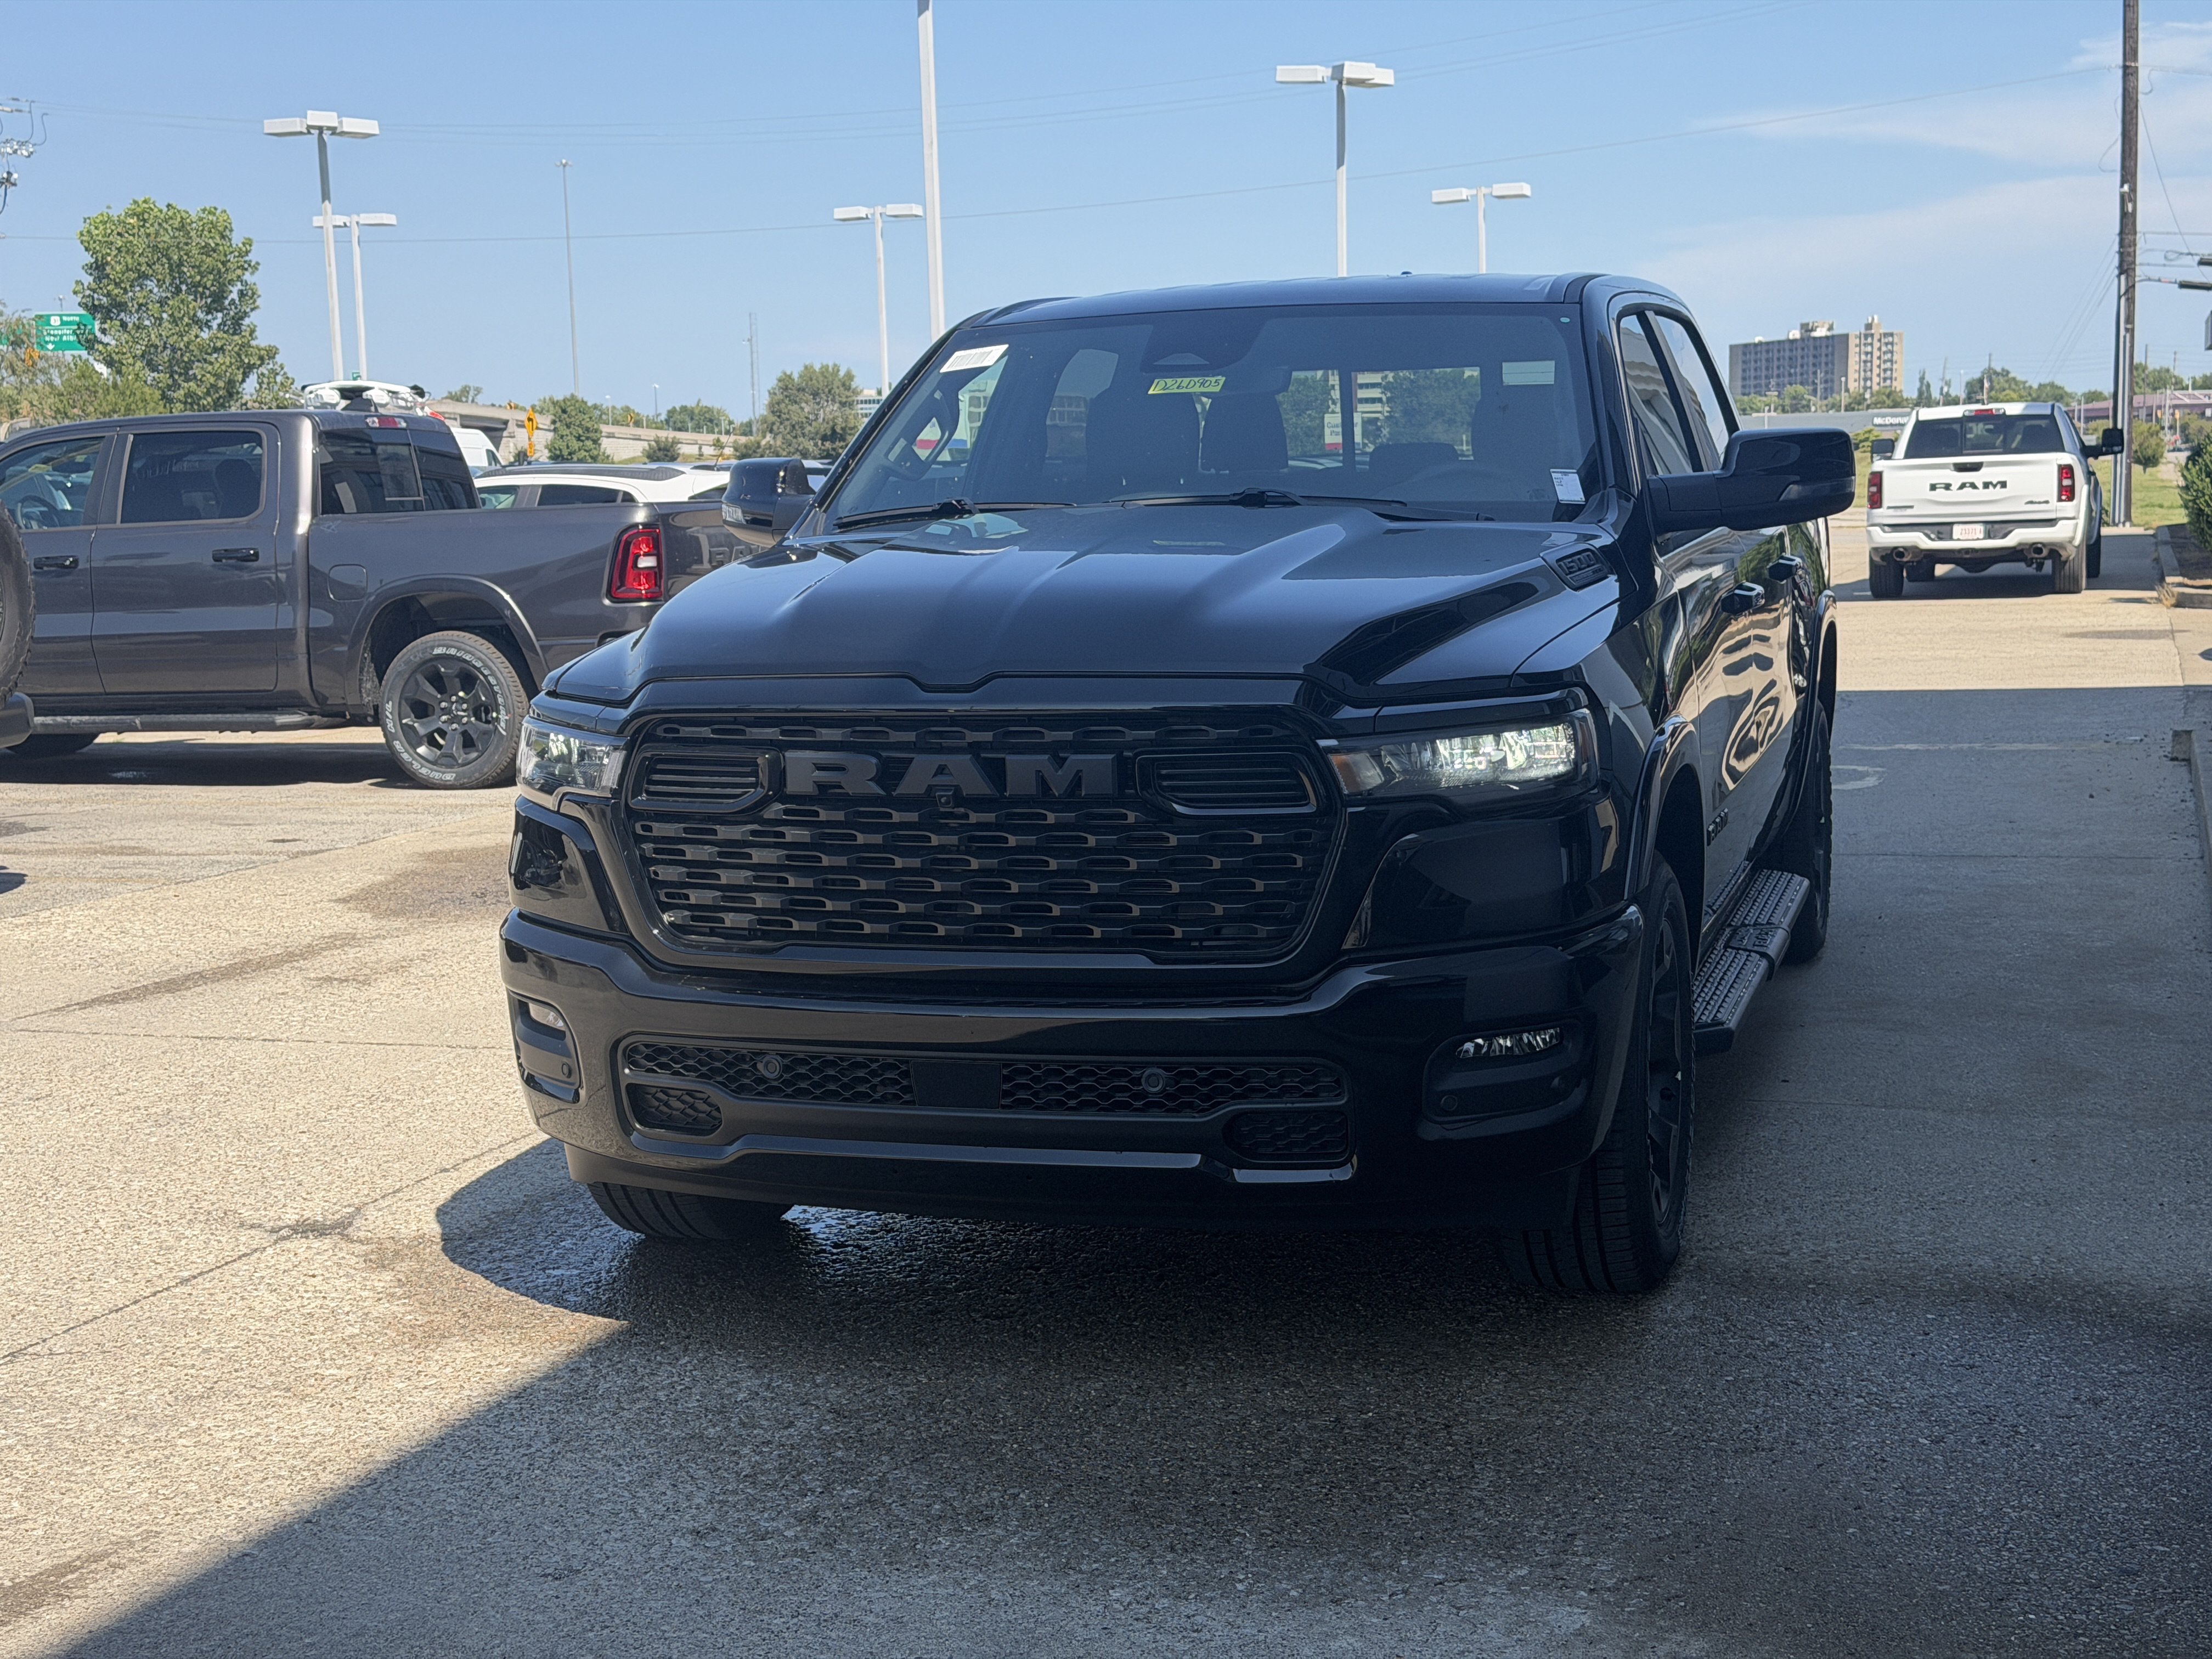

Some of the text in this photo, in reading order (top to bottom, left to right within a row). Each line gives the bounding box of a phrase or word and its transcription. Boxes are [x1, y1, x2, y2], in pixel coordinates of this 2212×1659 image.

[1929, 480, 2007, 492] RAM
[1558, 551, 1596, 574] 1500
[784, 750, 1117, 798] RAM
